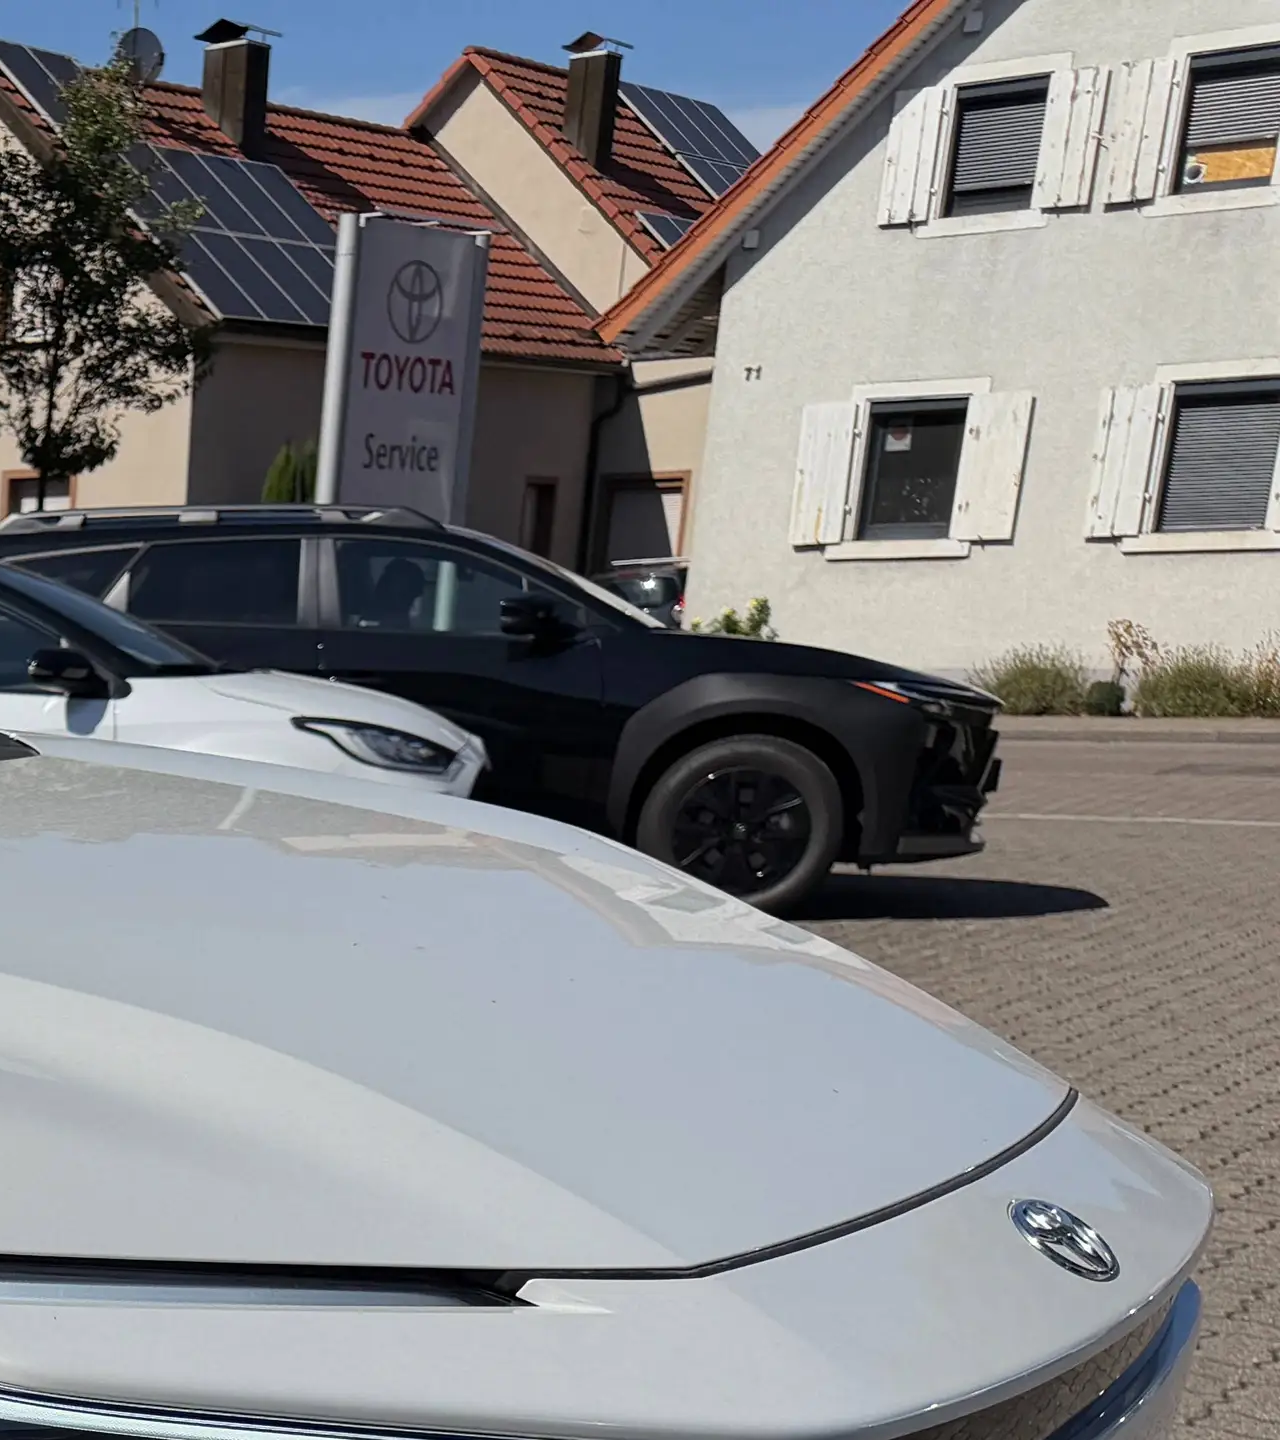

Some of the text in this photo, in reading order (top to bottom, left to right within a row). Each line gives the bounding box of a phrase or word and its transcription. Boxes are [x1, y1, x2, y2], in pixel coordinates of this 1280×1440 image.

[360, 352, 455, 394] TOYOTA
[744, 366, 761, 381] 71
[362, 433, 439, 472] Service
